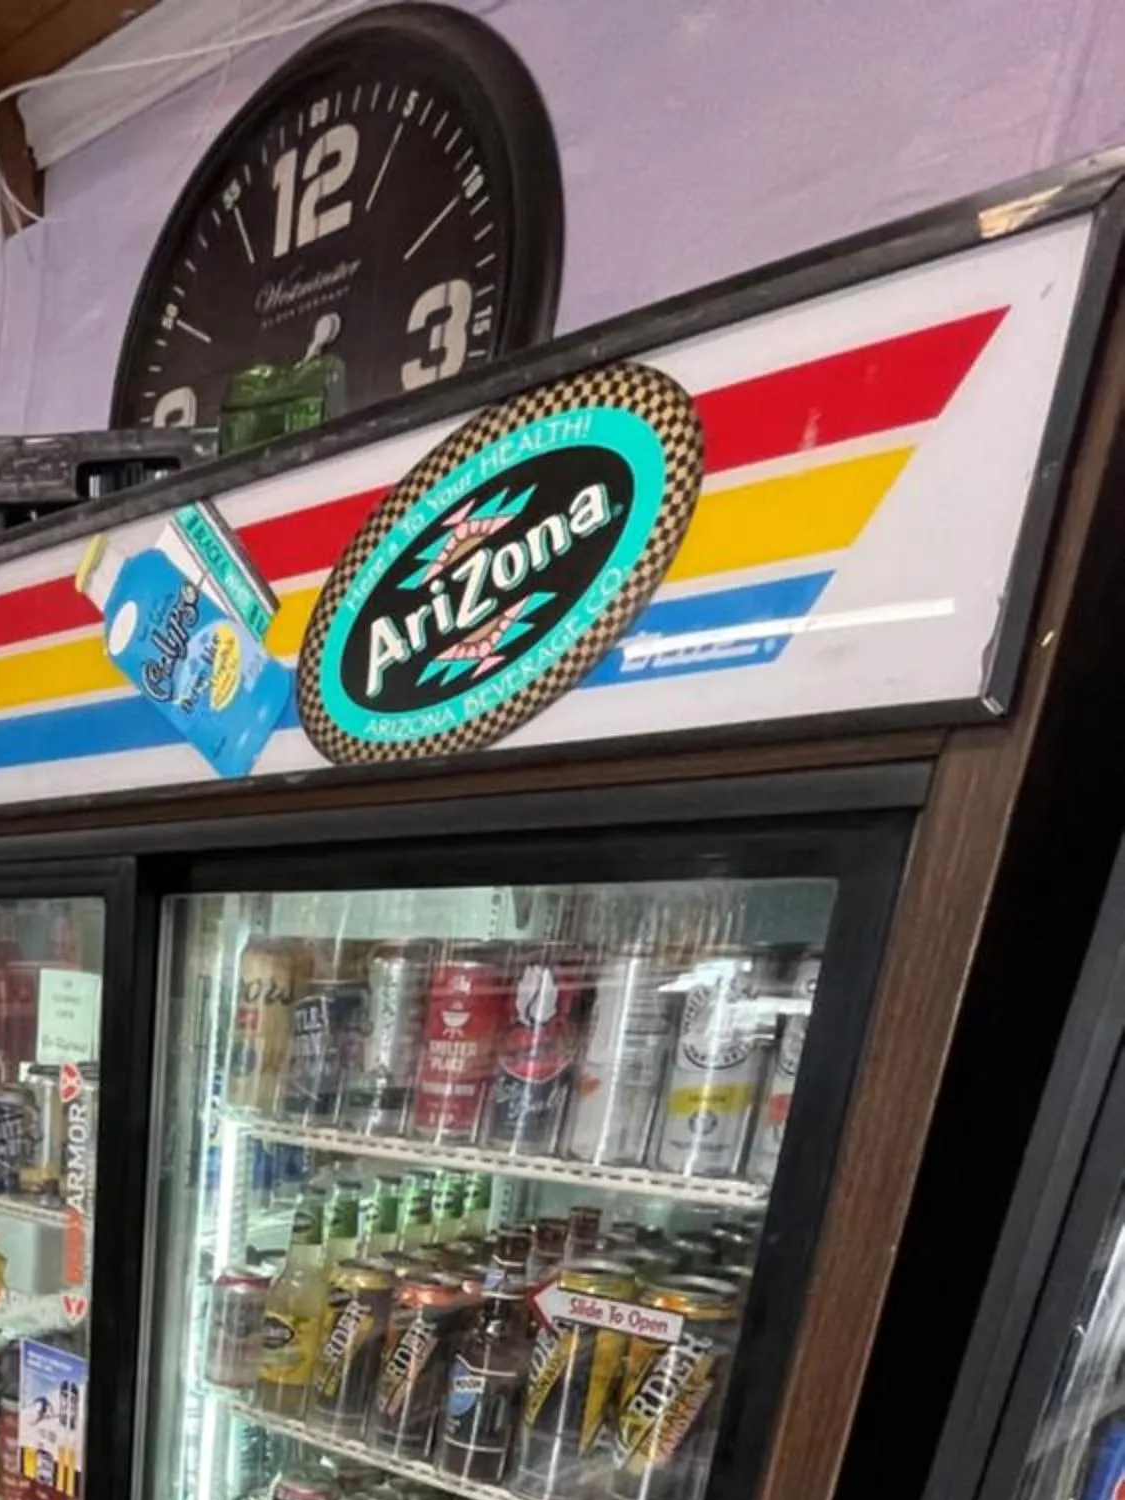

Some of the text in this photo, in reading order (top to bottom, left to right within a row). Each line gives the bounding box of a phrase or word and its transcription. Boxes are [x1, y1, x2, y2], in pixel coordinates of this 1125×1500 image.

[402, 90, 419, 118] 5
[272, 123, 360, 258] 12
[401, 278, 473, 391] 3
[479, 413, 594, 477] HEALTH!
[365, 482, 612, 699] AriZona
[363, 707, 457, 739] ARIZONA
[461, 612, 587, 722] BEVERAGE
[65, 1102, 89, 1214] ARMOR
[569, 1297, 669, 1335] Slide To Open
